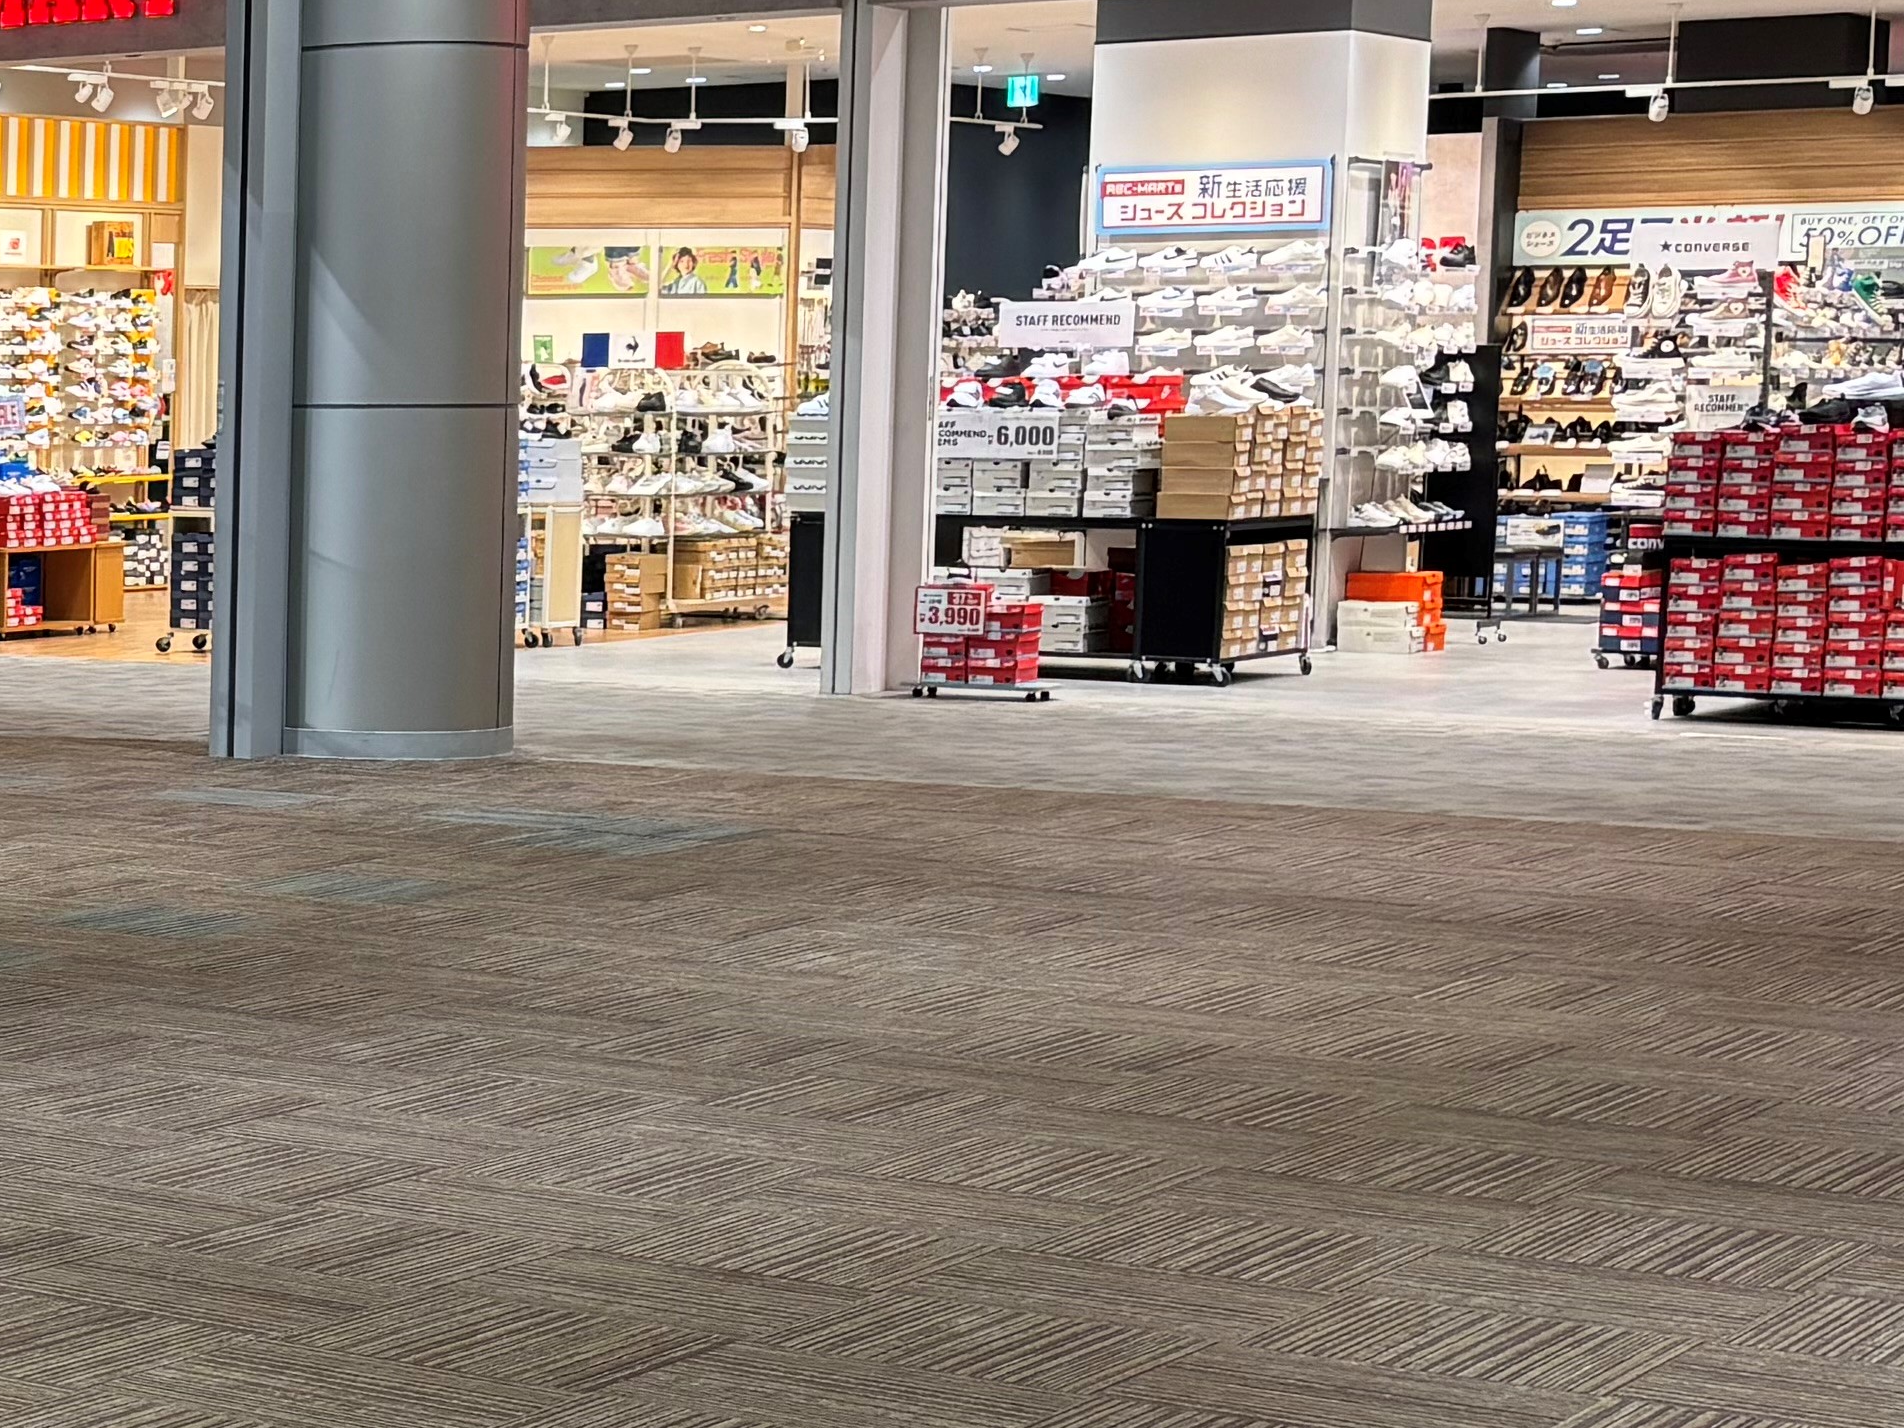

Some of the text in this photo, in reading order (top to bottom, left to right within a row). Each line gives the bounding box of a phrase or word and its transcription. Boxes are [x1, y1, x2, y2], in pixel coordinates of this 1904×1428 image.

[1198, 174, 1307, 199] 新生活応援
[1800, 217, 1823, 225] BUY
[1862, 215, 1886, 224] GET
[1858, 225, 1904, 246] OF
[1015, 314, 1121, 326] STAFF RECOMMEND
[1708, 394, 1736, 403] STAFF
[996, 425, 1055, 447] 6,000
[928, 606, 981, 627] 3,990
